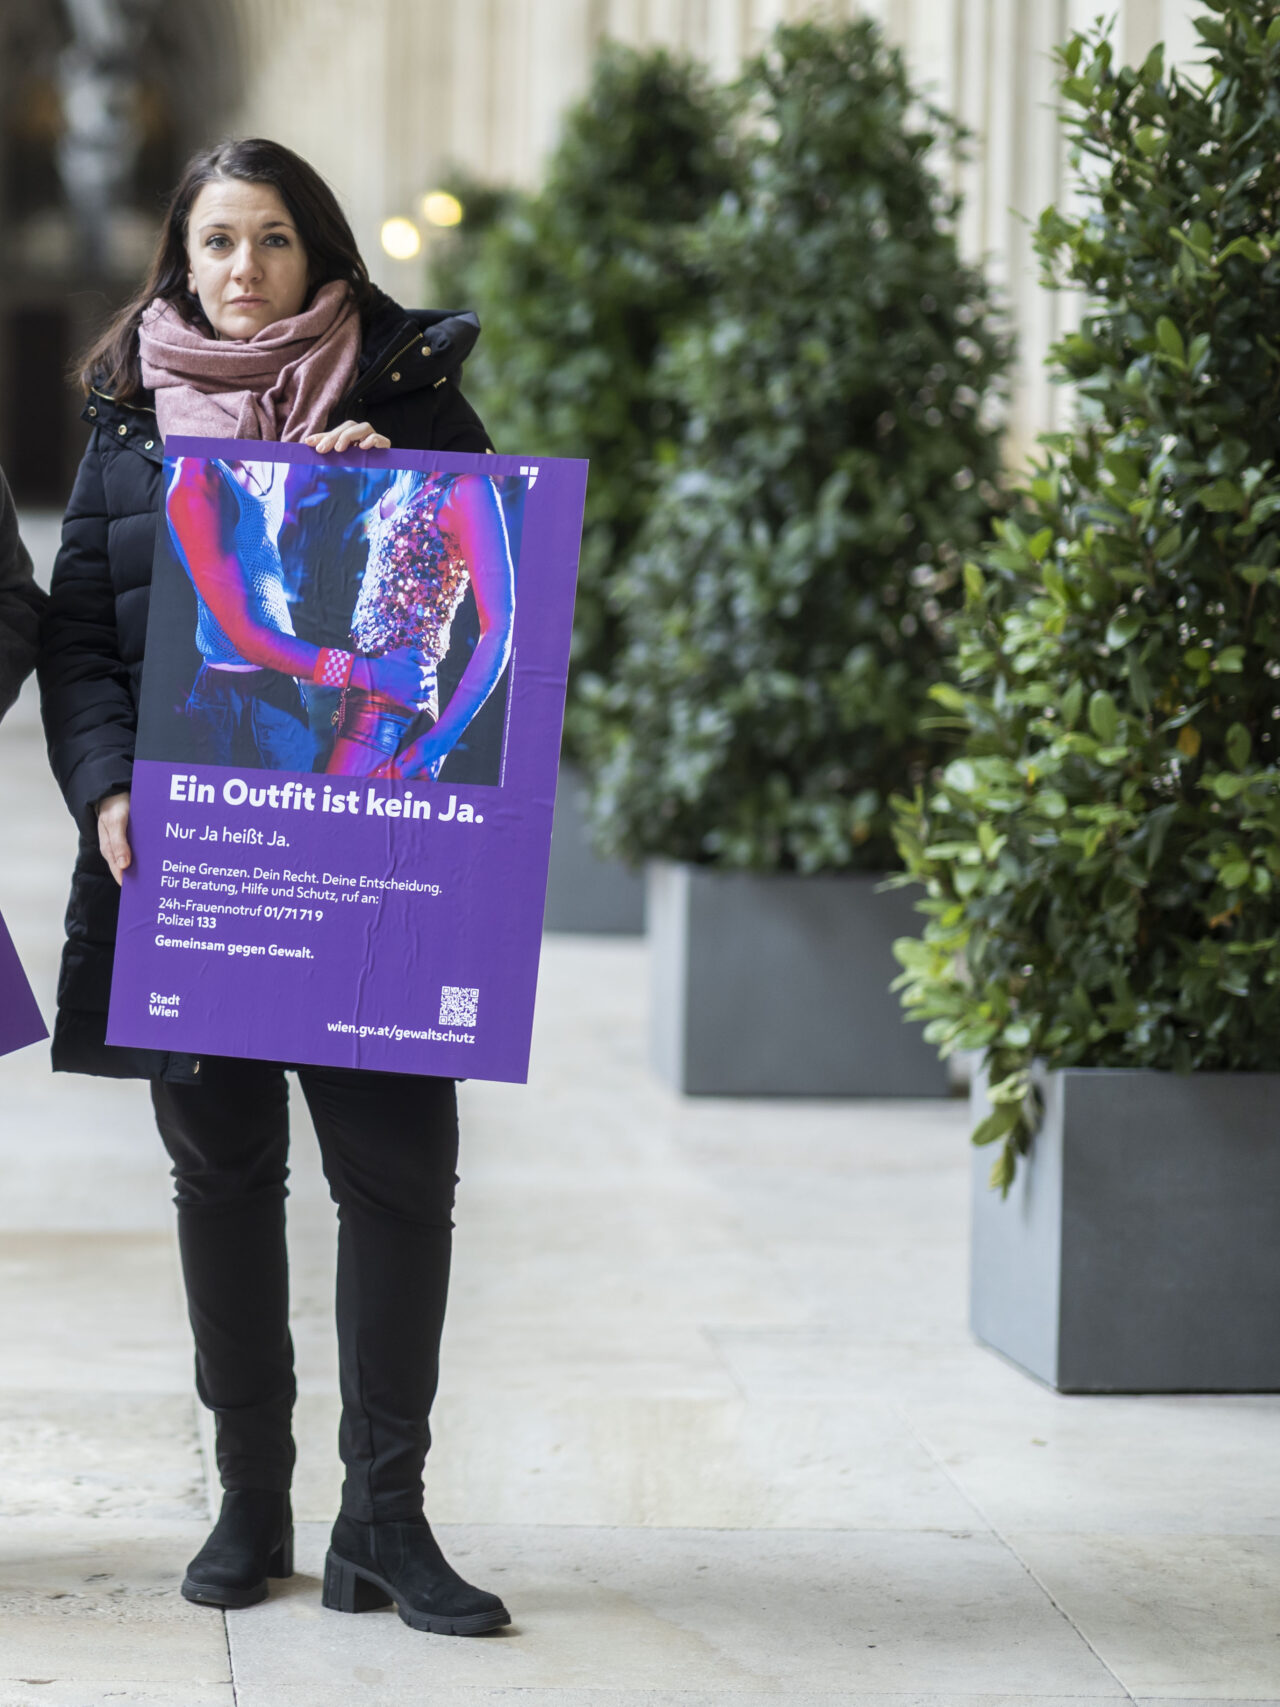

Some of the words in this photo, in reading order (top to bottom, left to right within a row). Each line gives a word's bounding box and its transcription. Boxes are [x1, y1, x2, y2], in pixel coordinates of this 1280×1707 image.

[169, 774, 216, 804] Ein
[222, 778, 316, 811] Outfit
[321, 784, 361, 815] ist
[366, 787, 431, 820] kein
[437, 794, 484, 824] Ja.
[165, 822, 197, 840] Nur
[199, 825, 218, 842] Ja
[222, 826, 264, 845] heißt
[266, 830, 290, 848] Ja.
[160, 875, 180, 888] Für
[182, 877, 239, 896] Beratung,
[241, 881, 269, 896] Hilfe
[271, 885, 295, 898] und
[296, 886, 339, 903] Schutz,
[341, 890, 360, 903] ruf
[360, 894, 379, 905] an:
[162, 859, 197, 874] Deine
[198, 862, 251, 878] Grenzen.
[253, 867, 281, 881] Dein
[282, 869, 320, 884] Recht.
[322, 872, 357, 887] Deine
[359, 875, 442, 897] Entscheidung.
[158, 897, 263, 917] 24h-Frauennotruf
[157, 912, 195, 927] Polizei
[196, 916, 217, 929] 133
[154, 934, 226, 952] Gemeinsam
[227, 943, 266, 957] gegen
[267, 944, 315, 959] Gewalt.
[149, 991, 181, 1006] Stadt
[148, 1004, 179, 1018] Wien
[327, 1020, 476, 1044] wien.gv.at/gewaltschutz
